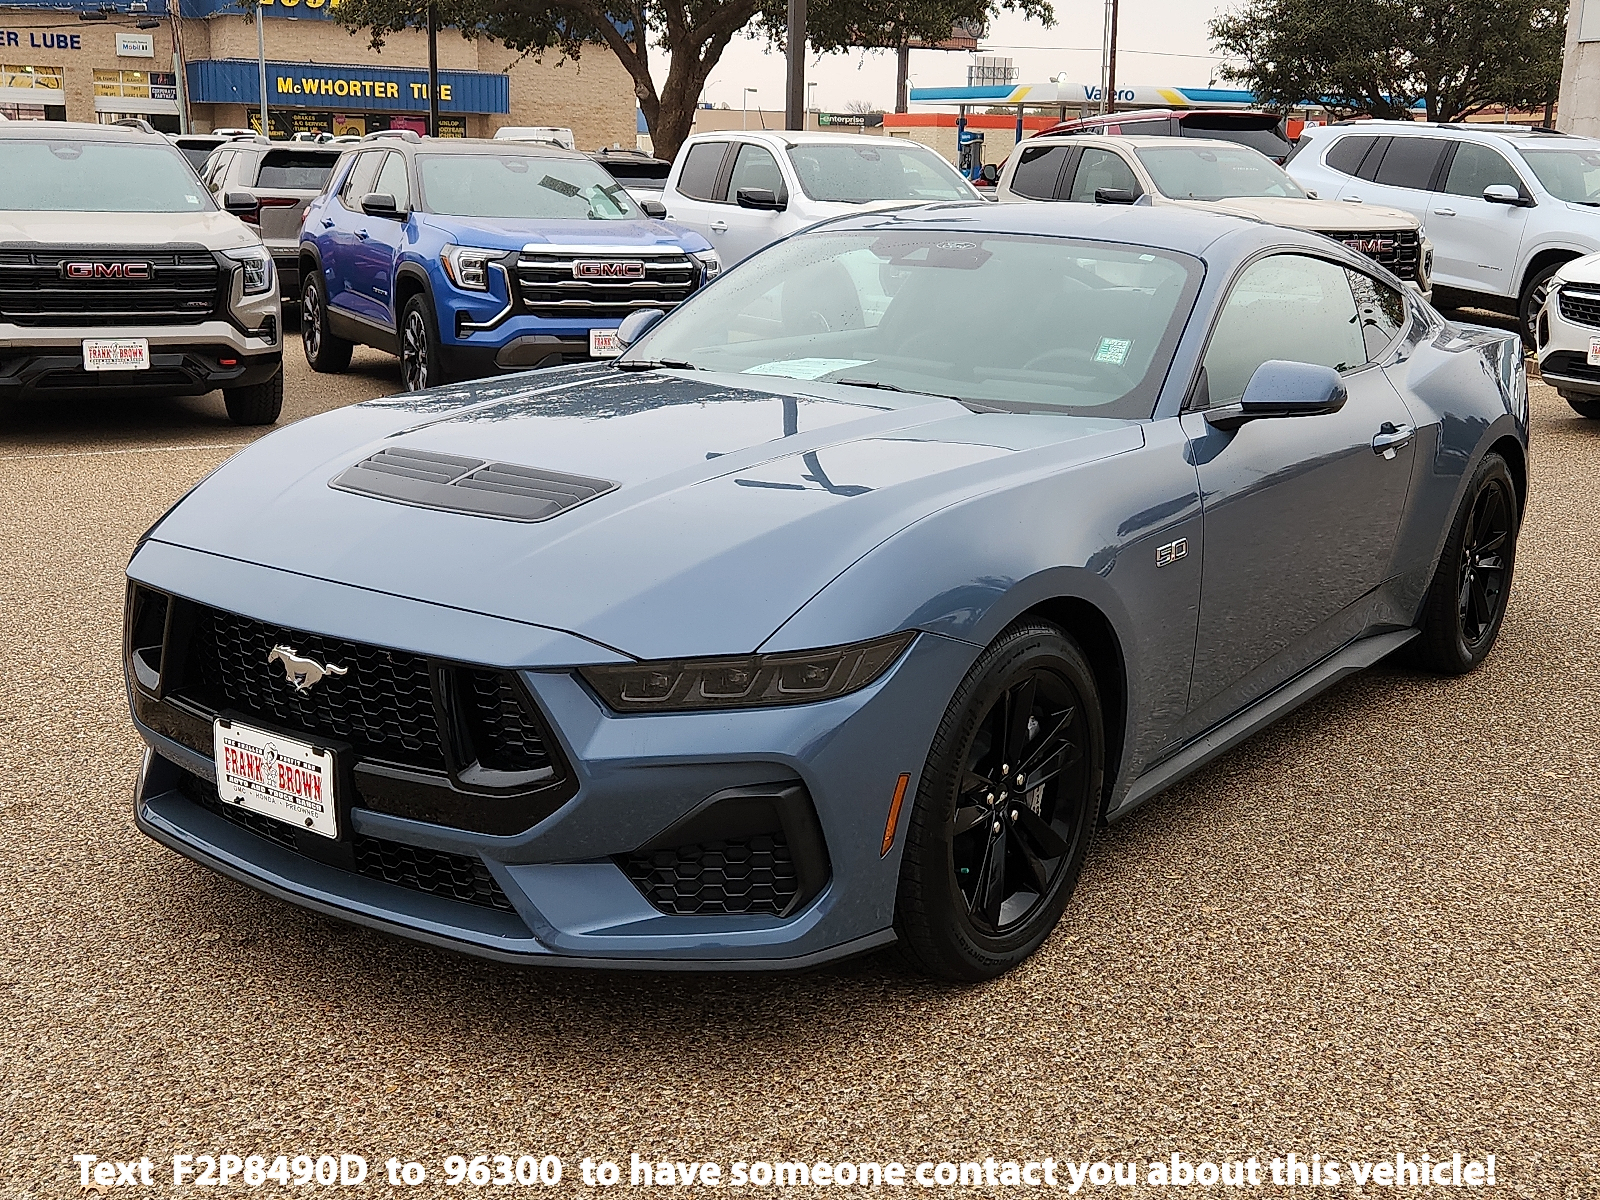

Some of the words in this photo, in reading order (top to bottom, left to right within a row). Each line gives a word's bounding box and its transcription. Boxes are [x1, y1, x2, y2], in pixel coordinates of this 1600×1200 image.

[30, 32, 82, 50] LUBE
[277, 76, 399, 99] McWHORTER
[410, 83, 452, 101] TIE
[823, 115, 865, 125] enterprise
[1342, 239, 1394, 252] GMC
[67, 263, 149, 278] GMC
[581, 263, 642, 276] GMC
[224, 746, 265, 783] FRANK
[277, 762, 323, 803] BROWN
[229, 776, 249, 788] AUTO
[250, 783, 267, 793] AND
[269, 788, 294, 803] TRUCK
[233, 785, 247, 795] GMC
[255, 792, 277, 805] HONDA
[285, 802, 319, 819] PREOWNED
